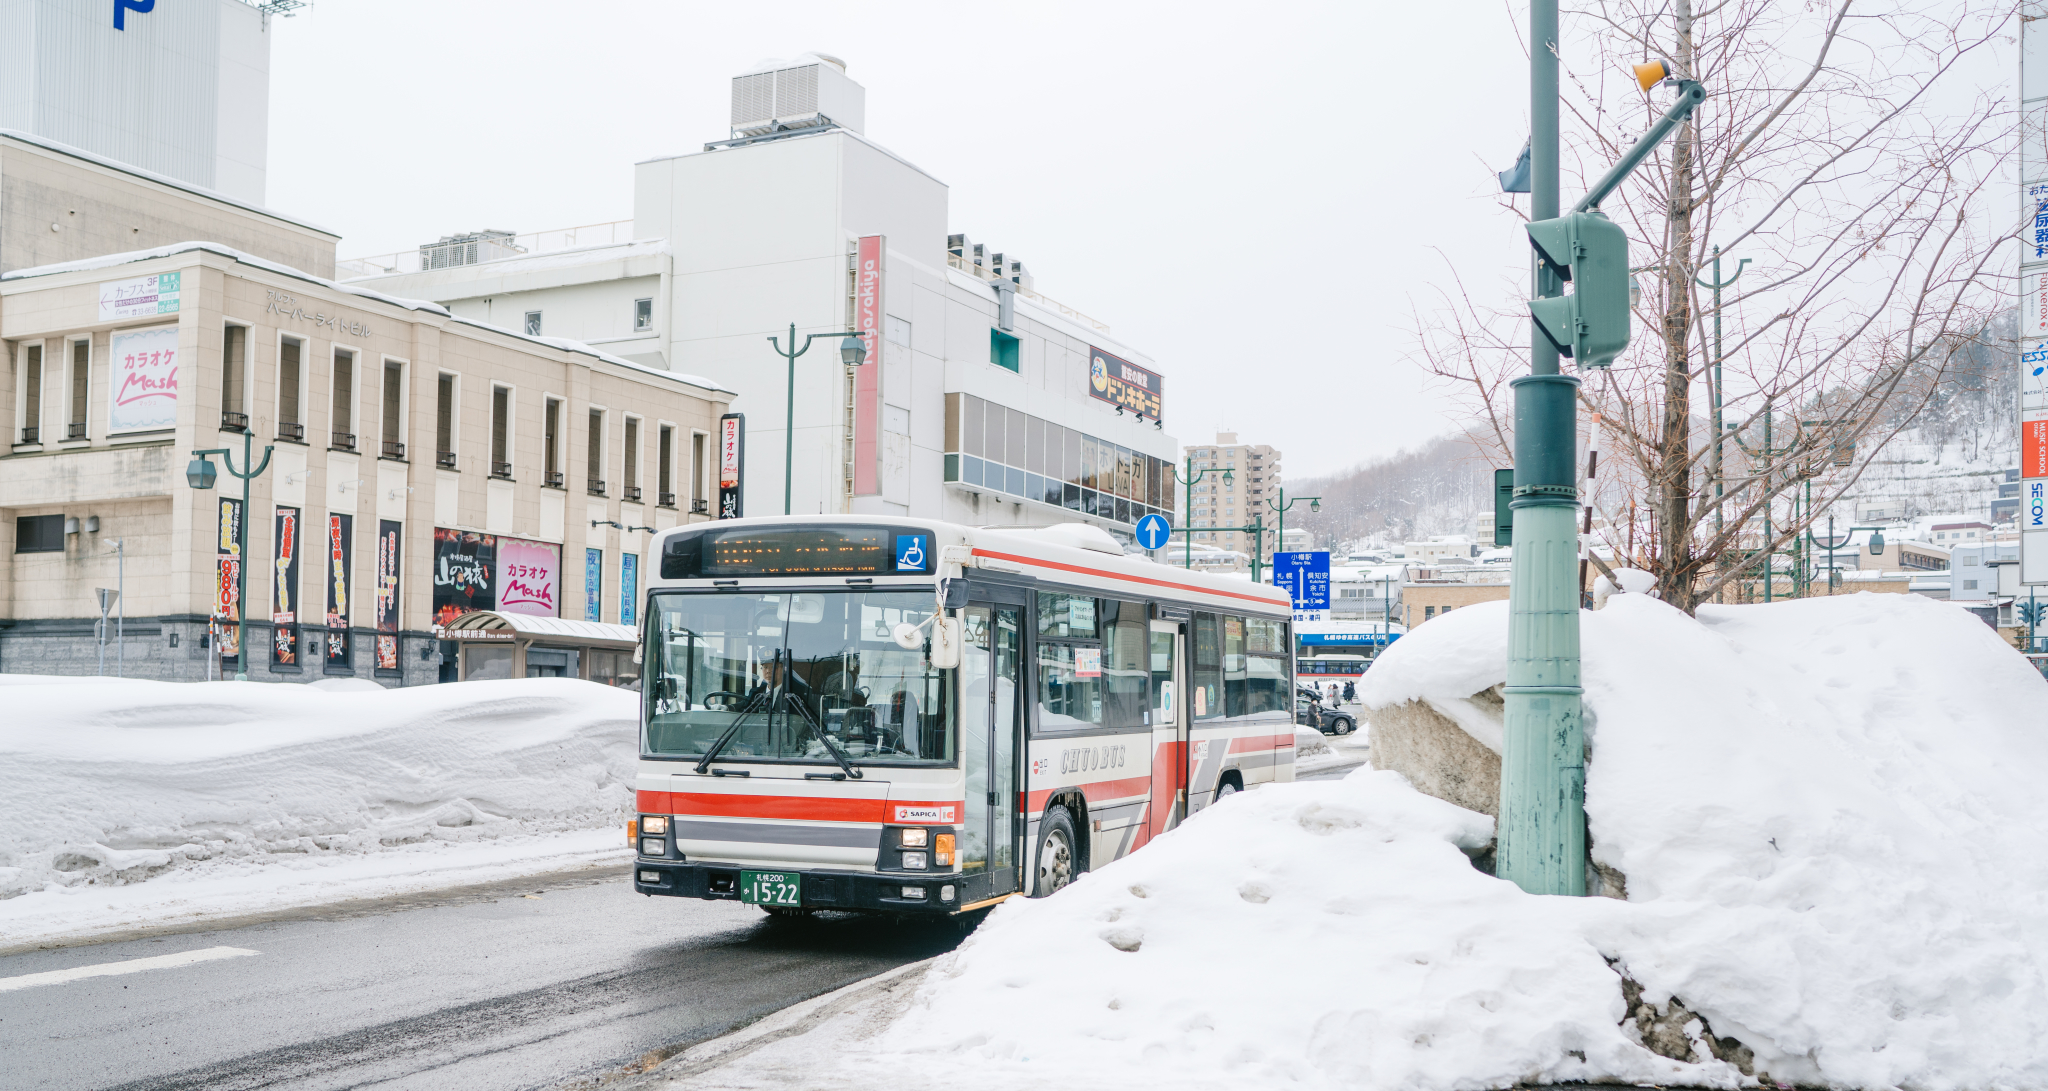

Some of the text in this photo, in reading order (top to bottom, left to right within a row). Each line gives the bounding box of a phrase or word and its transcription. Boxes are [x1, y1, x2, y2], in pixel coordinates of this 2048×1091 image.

[147, 276, 158, 287] 3F
[267, 289, 298, 305] アルファ
[2040, 291, 2048, 320] xerox
[267, 302, 372, 338] ハーバーライトビル
[860, 259, 879, 365] Nagasakiya
[124, 349, 175, 370] カラオケ
[116, 366, 178, 403] Mash
[726, 420, 735, 461] カラオケ
[2031, 483, 2043, 525] SECOM
[587, 551, 597, 566] 夜
[1291, 553, 1312, 561] 小樽駅
[435, 556, 487, 590] 山の猿
[508, 563, 548, 580] カラオケ
[1277, 572, 1293, 580] 札幌
[501, 579, 552, 603] Mash
[446, 629, 487, 639] 小樽駅前通
[753, 882, 798, 904] 15-22
